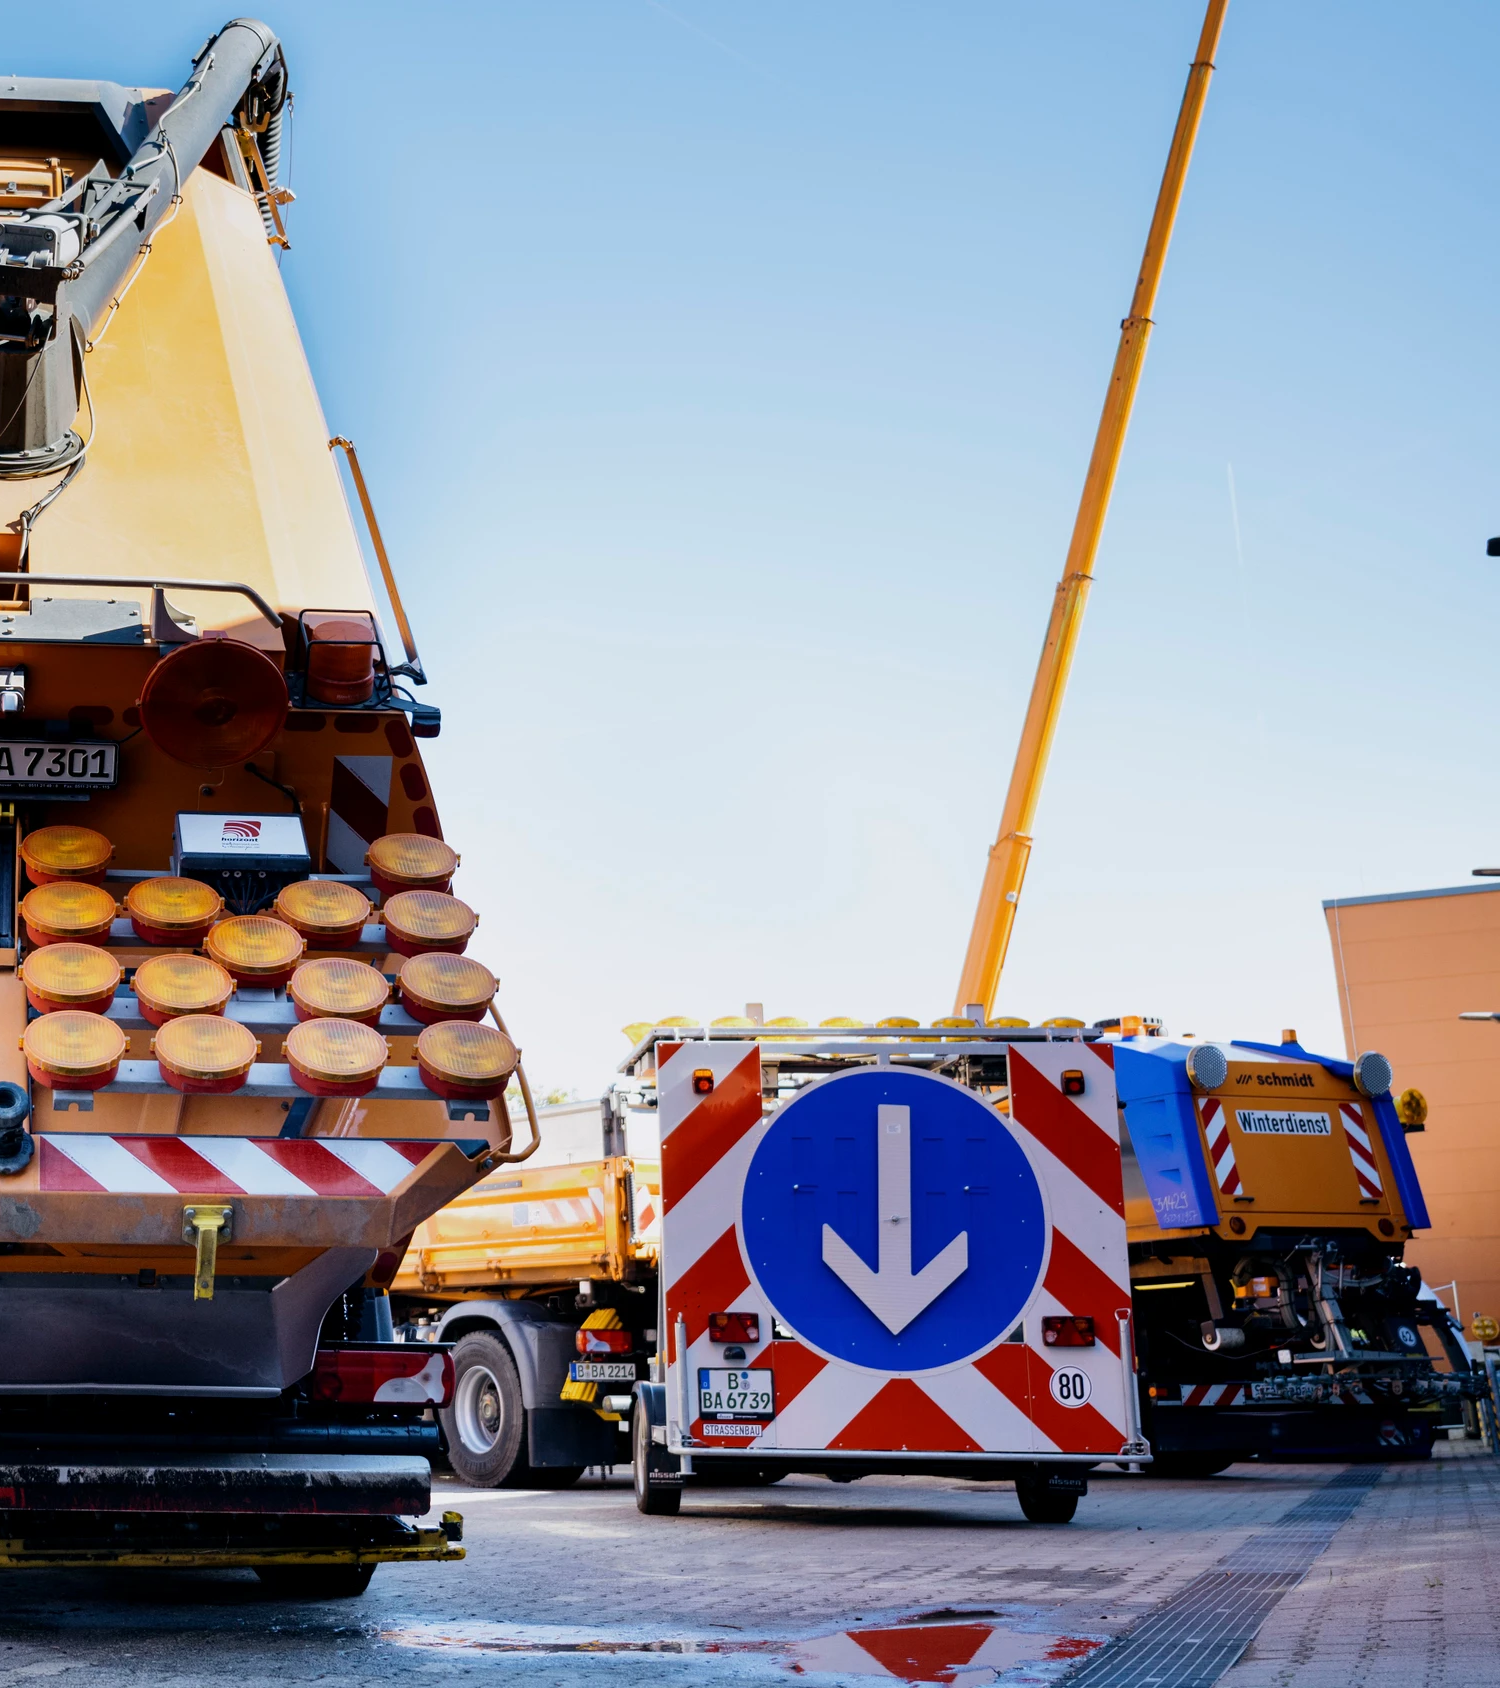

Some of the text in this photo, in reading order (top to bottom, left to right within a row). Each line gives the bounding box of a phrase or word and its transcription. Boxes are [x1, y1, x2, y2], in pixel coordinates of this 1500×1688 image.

[24, 747, 110, 778] 7301
[1256, 1072, 1315, 1087] schmidt
[1238, 1111, 1330, 1135] Winterdienst
[577, 1365, 635, 1378] B BA 2214
[728, 1373, 739, 1390] B
[1059, 1373, 1085, 1400] 80
[703, 1392, 771, 1410] BA 6739
[704, 1424, 760, 1436] STRASSENBAU
[649, 1468, 681, 1479] nissen
[1049, 1475, 1082, 1486] nissen
